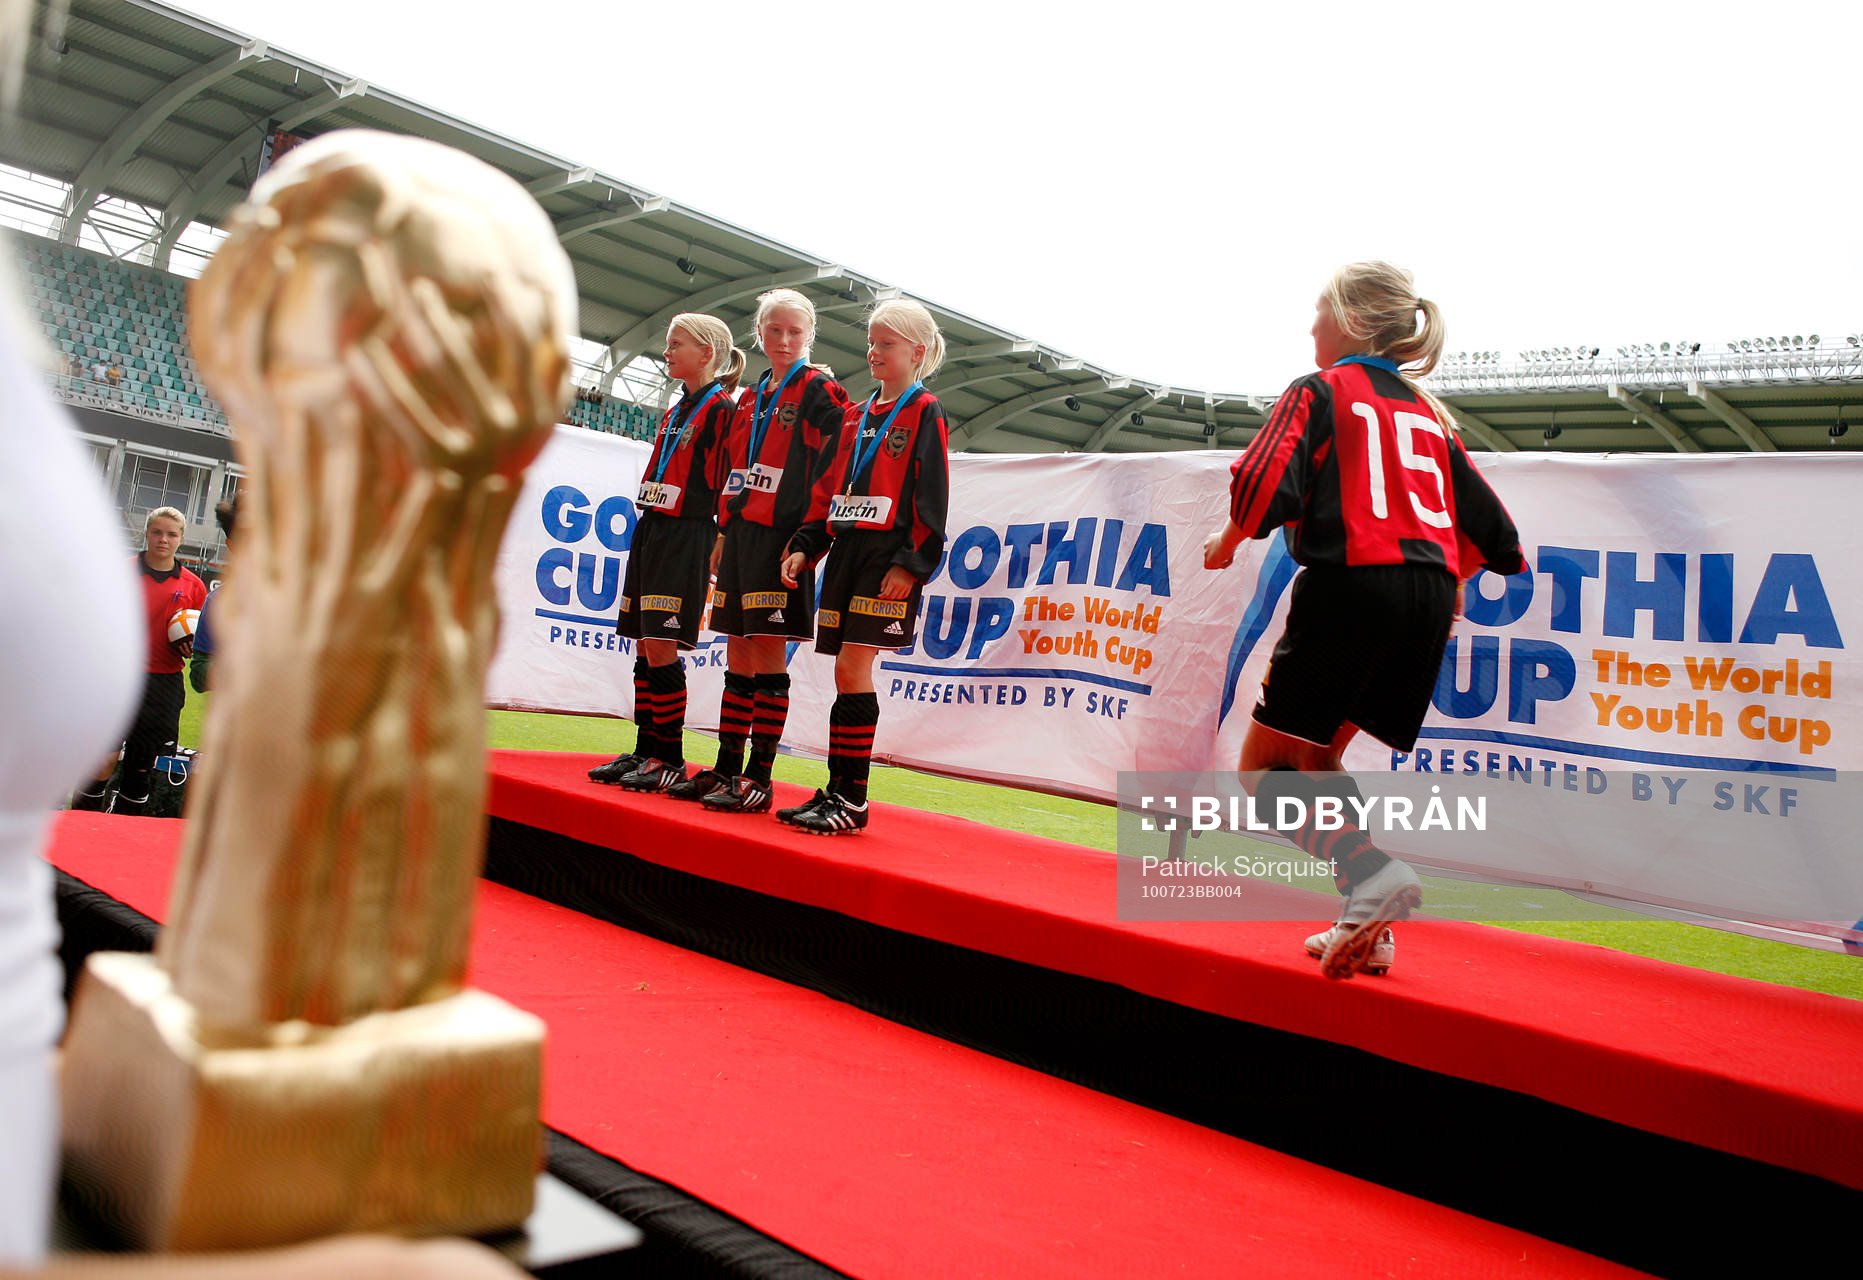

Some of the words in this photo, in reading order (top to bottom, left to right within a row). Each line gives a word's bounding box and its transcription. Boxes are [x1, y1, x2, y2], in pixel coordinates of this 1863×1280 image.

[1351, 402, 1453, 529] 15
[755, 594, 785, 606] GROSS
[872, 601, 904, 616] GROSS
[1024, 596, 1075, 621] The
[1083, 596, 1162, 634] World
[1018, 629, 1097, 659] Youth
[1105, 636, 1153, 675] Cup
[1591, 649, 1671, 687] The
[1683, 656, 1832, 699] World
[889, 679, 1027, 706] PRESENTED
[1043, 687, 1075, 708] BY
[1086, 691, 1129, 720] SKF
[1590, 692, 1723, 737] Youth
[1738, 704, 1831, 755] Cup
[1391, 748, 1608, 795] PRESENTED
[1632, 773, 1688, 805] BY
[1713, 781, 1798, 817] SKF
